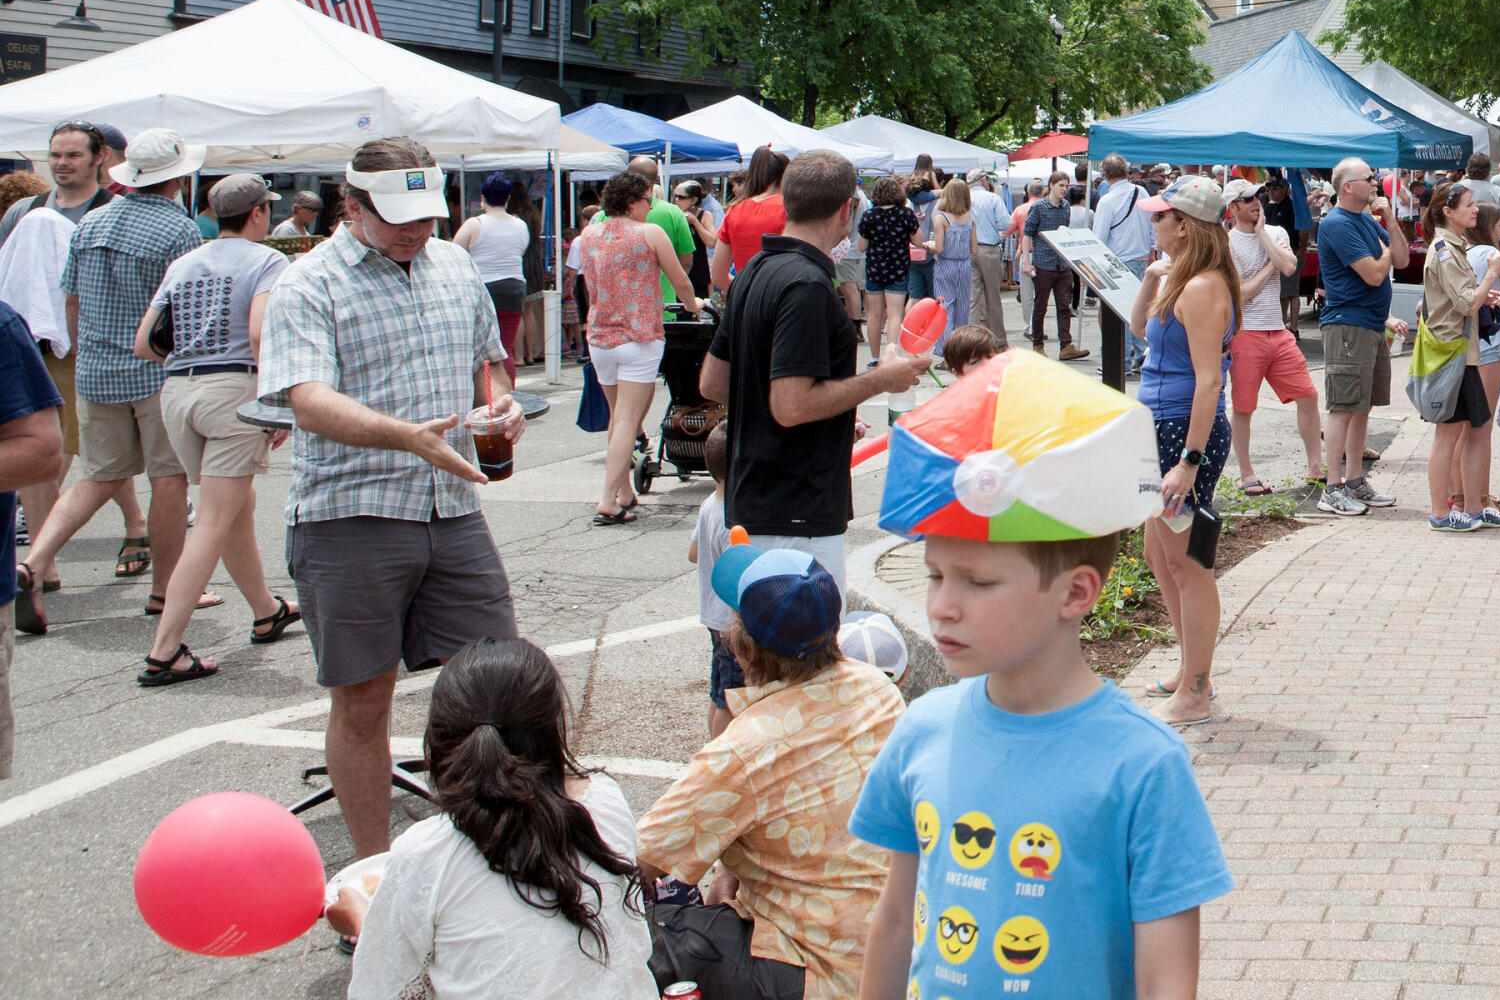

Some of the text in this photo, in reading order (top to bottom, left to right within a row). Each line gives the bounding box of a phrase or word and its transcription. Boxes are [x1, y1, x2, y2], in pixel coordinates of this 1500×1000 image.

[945, 871, 989, 891] AWESOME
[1014, 882, 1046, 898] TIRED
[1003, 978, 1031, 993] WOW
